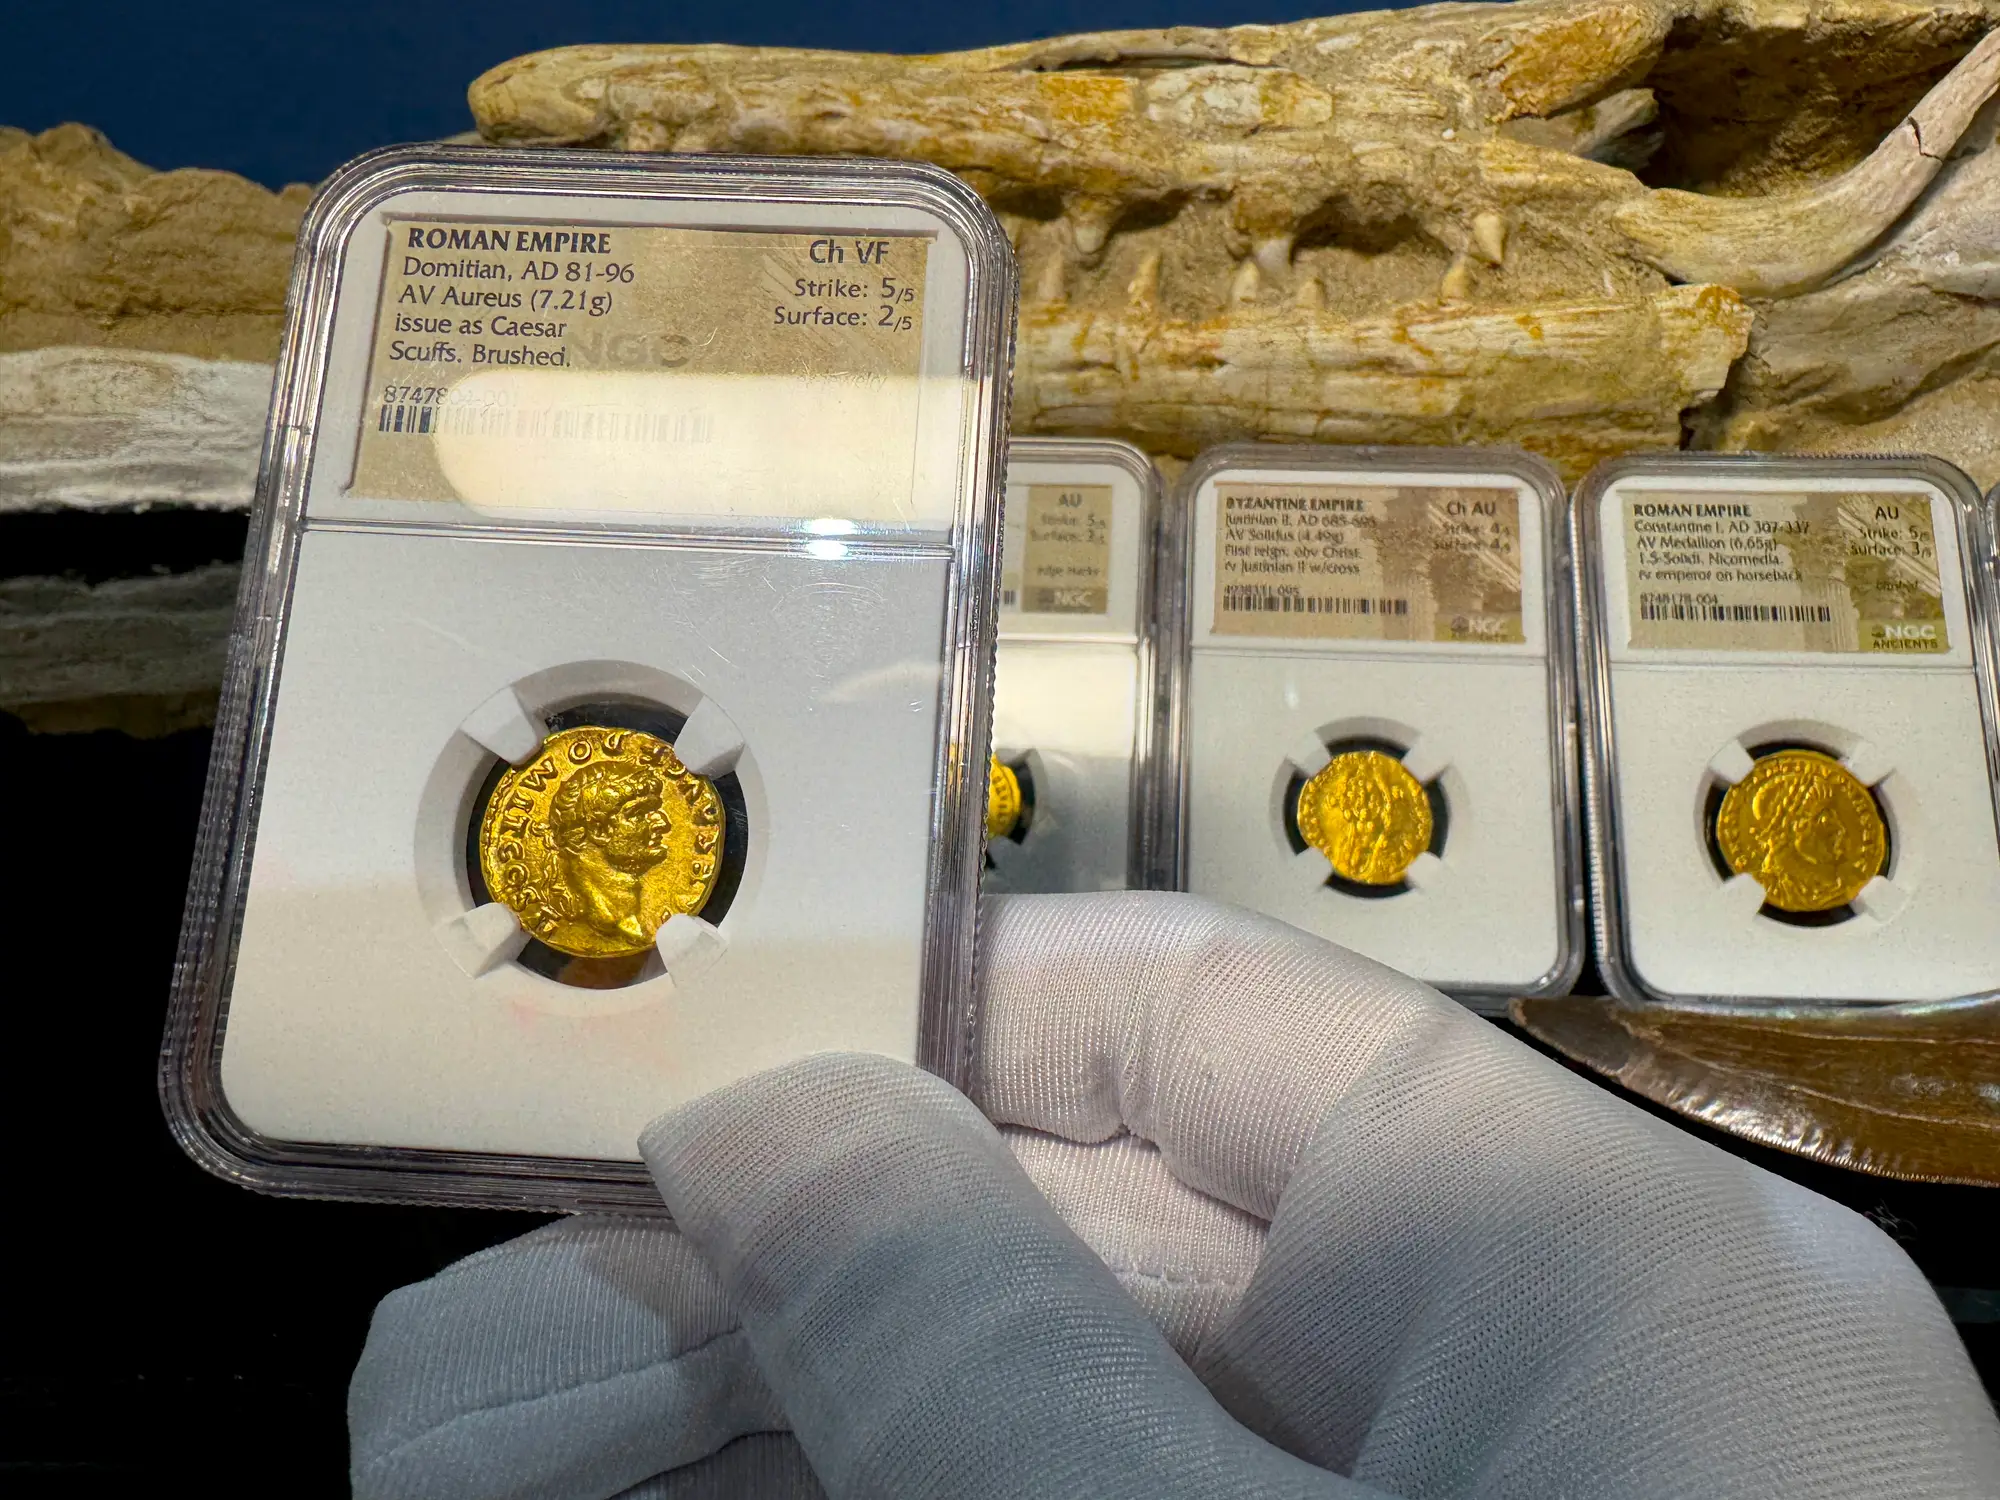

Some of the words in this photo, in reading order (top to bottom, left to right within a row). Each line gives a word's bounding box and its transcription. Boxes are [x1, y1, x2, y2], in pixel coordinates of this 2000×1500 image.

[408, 228, 511, 251] ROMAN
[515, 231, 611, 254] EMPIRE
[809, 239, 844, 264] Ch
[855, 241, 889, 264] VF
[403, 256, 513, 281] Domitian,
[521, 260, 558, 281] AD
[565, 262, 635, 283] 81-96
[794, 279, 868, 298] Strike:
[881, 277, 914, 304] 5/5
[398, 284, 435, 305] AV
[441, 286, 522, 307] Aureus
[531, 290, 612, 317] (7.21g)
[395, 313, 452, 333] issue
[458, 318, 483, 335] as
[491, 316, 568, 338] Caesar
[774, 305, 868, 326] Surface:
[878, 305, 912, 332] 2/5
[389, 340, 462, 363] Scuffs.
[1058, 494, 1082, 507] AU
[1226, 497, 1307, 510] BYZANTINE
[1310, 498, 1364, 512] EMPIRE
[1446, 501, 1467, 516] Ch
[1472, 501, 1496, 516] AU
[1633, 504, 1692, 517] ROMAN
[1696, 504, 1752, 517] EMPIRE
[1875, 506, 1899, 520] AU
[1297, 514, 1318, 526] AD
[1634, 520, 1712, 534] Constantine
[1728, 521, 1750, 534] AD
[1755, 520, 1810, 534] 307-337
[1225, 529, 1245, 541] AV
[1637, 536, 1656, 550] AV
[1660, 535, 1725, 549] Medallion
[1729, 536, 1777, 553] (6.65g)
[1655, 571, 1712, 583] emperor
[1715, 571, 1733, 582] on
[1737, 569, 1803, 583] horseback
[1885, 623, 1937, 640] NGC
[1872, 639, 1939, 650] ANCIENTS
